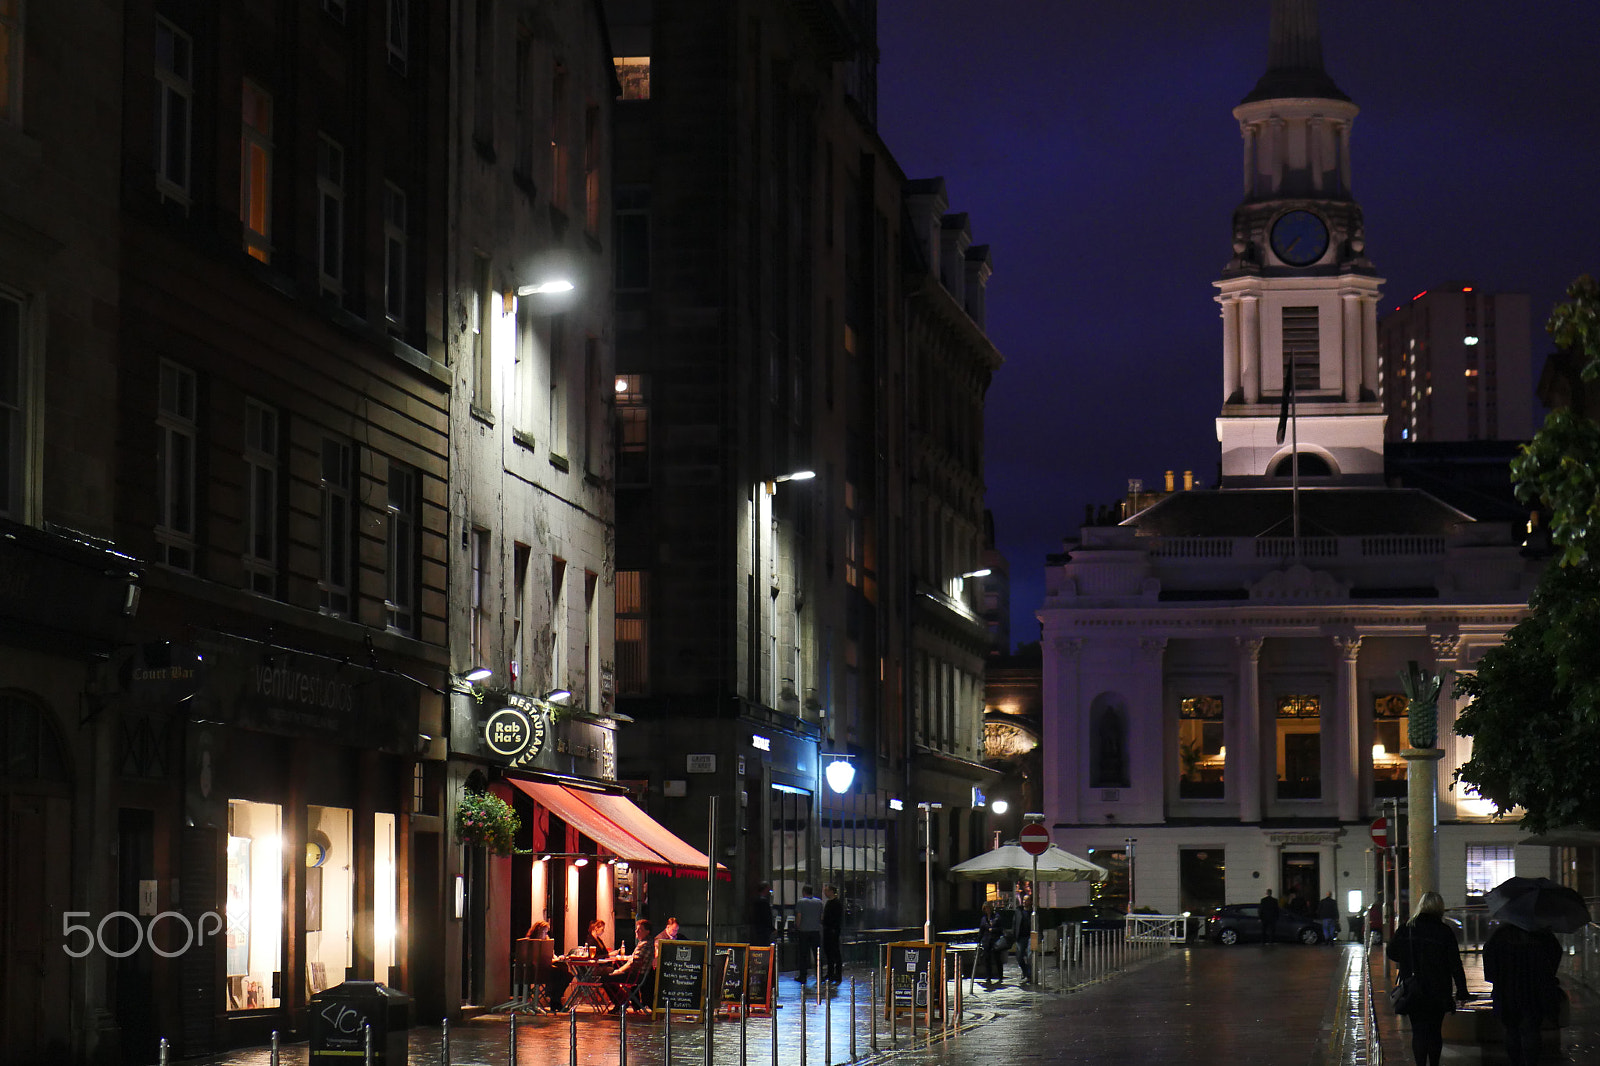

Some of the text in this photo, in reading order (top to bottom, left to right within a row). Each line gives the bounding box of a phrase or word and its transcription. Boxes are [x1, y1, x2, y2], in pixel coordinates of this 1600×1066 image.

[133, 667, 166, 680] Court
[256, 659, 353, 712] venturestudios
[495, 722, 521, 733] Rab
[510, 696, 544, 762] RESTAURANT
[494, 732, 522, 743] Ha's
